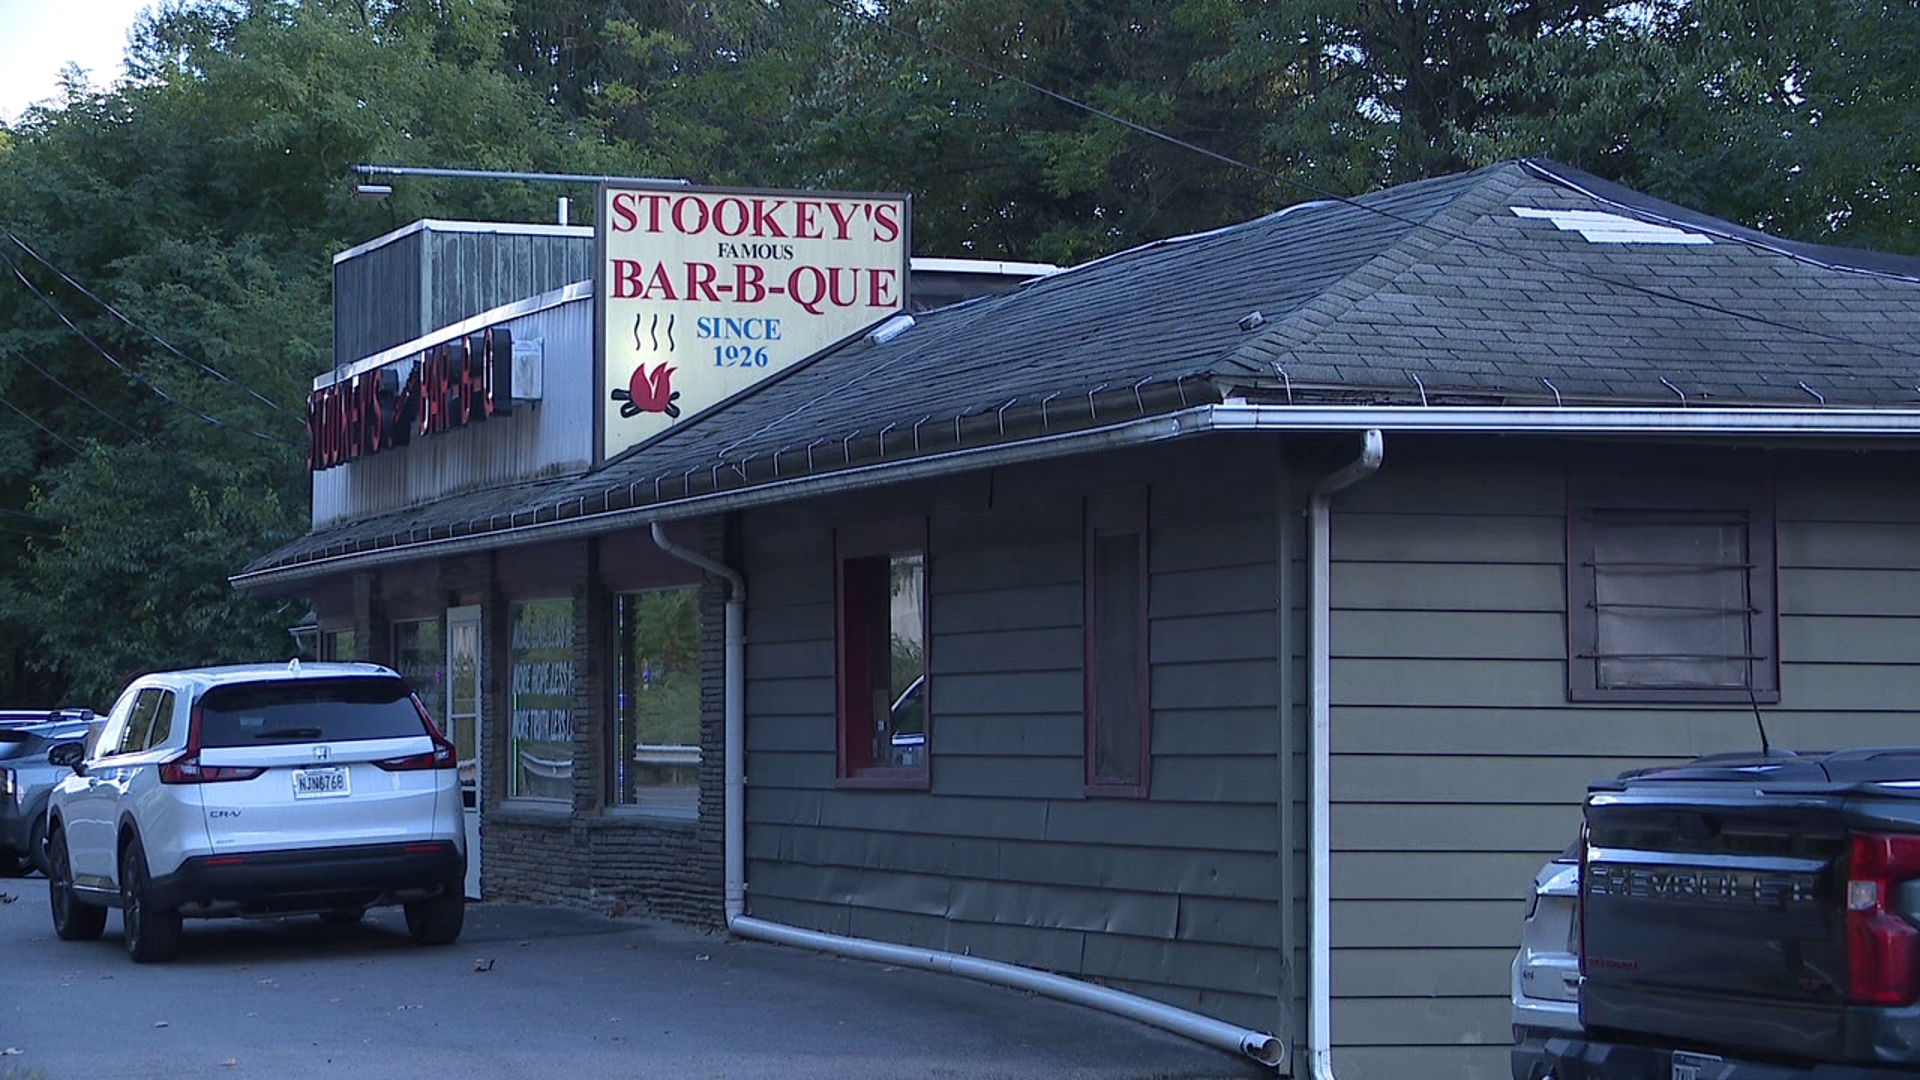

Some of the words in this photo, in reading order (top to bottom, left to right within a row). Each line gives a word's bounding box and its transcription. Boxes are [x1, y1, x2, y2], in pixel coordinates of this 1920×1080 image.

[611, 192, 900, 242] STOOKEY'S
[717, 242, 794, 260] FAMOUS
[609, 258, 899, 315] BAR-B-QUE
[696, 316, 782, 340] SINCE
[713, 345, 769, 368] 1926
[210, 810, 242, 818] CR-V
[1589, 866, 1814, 904] CHEVROLET
